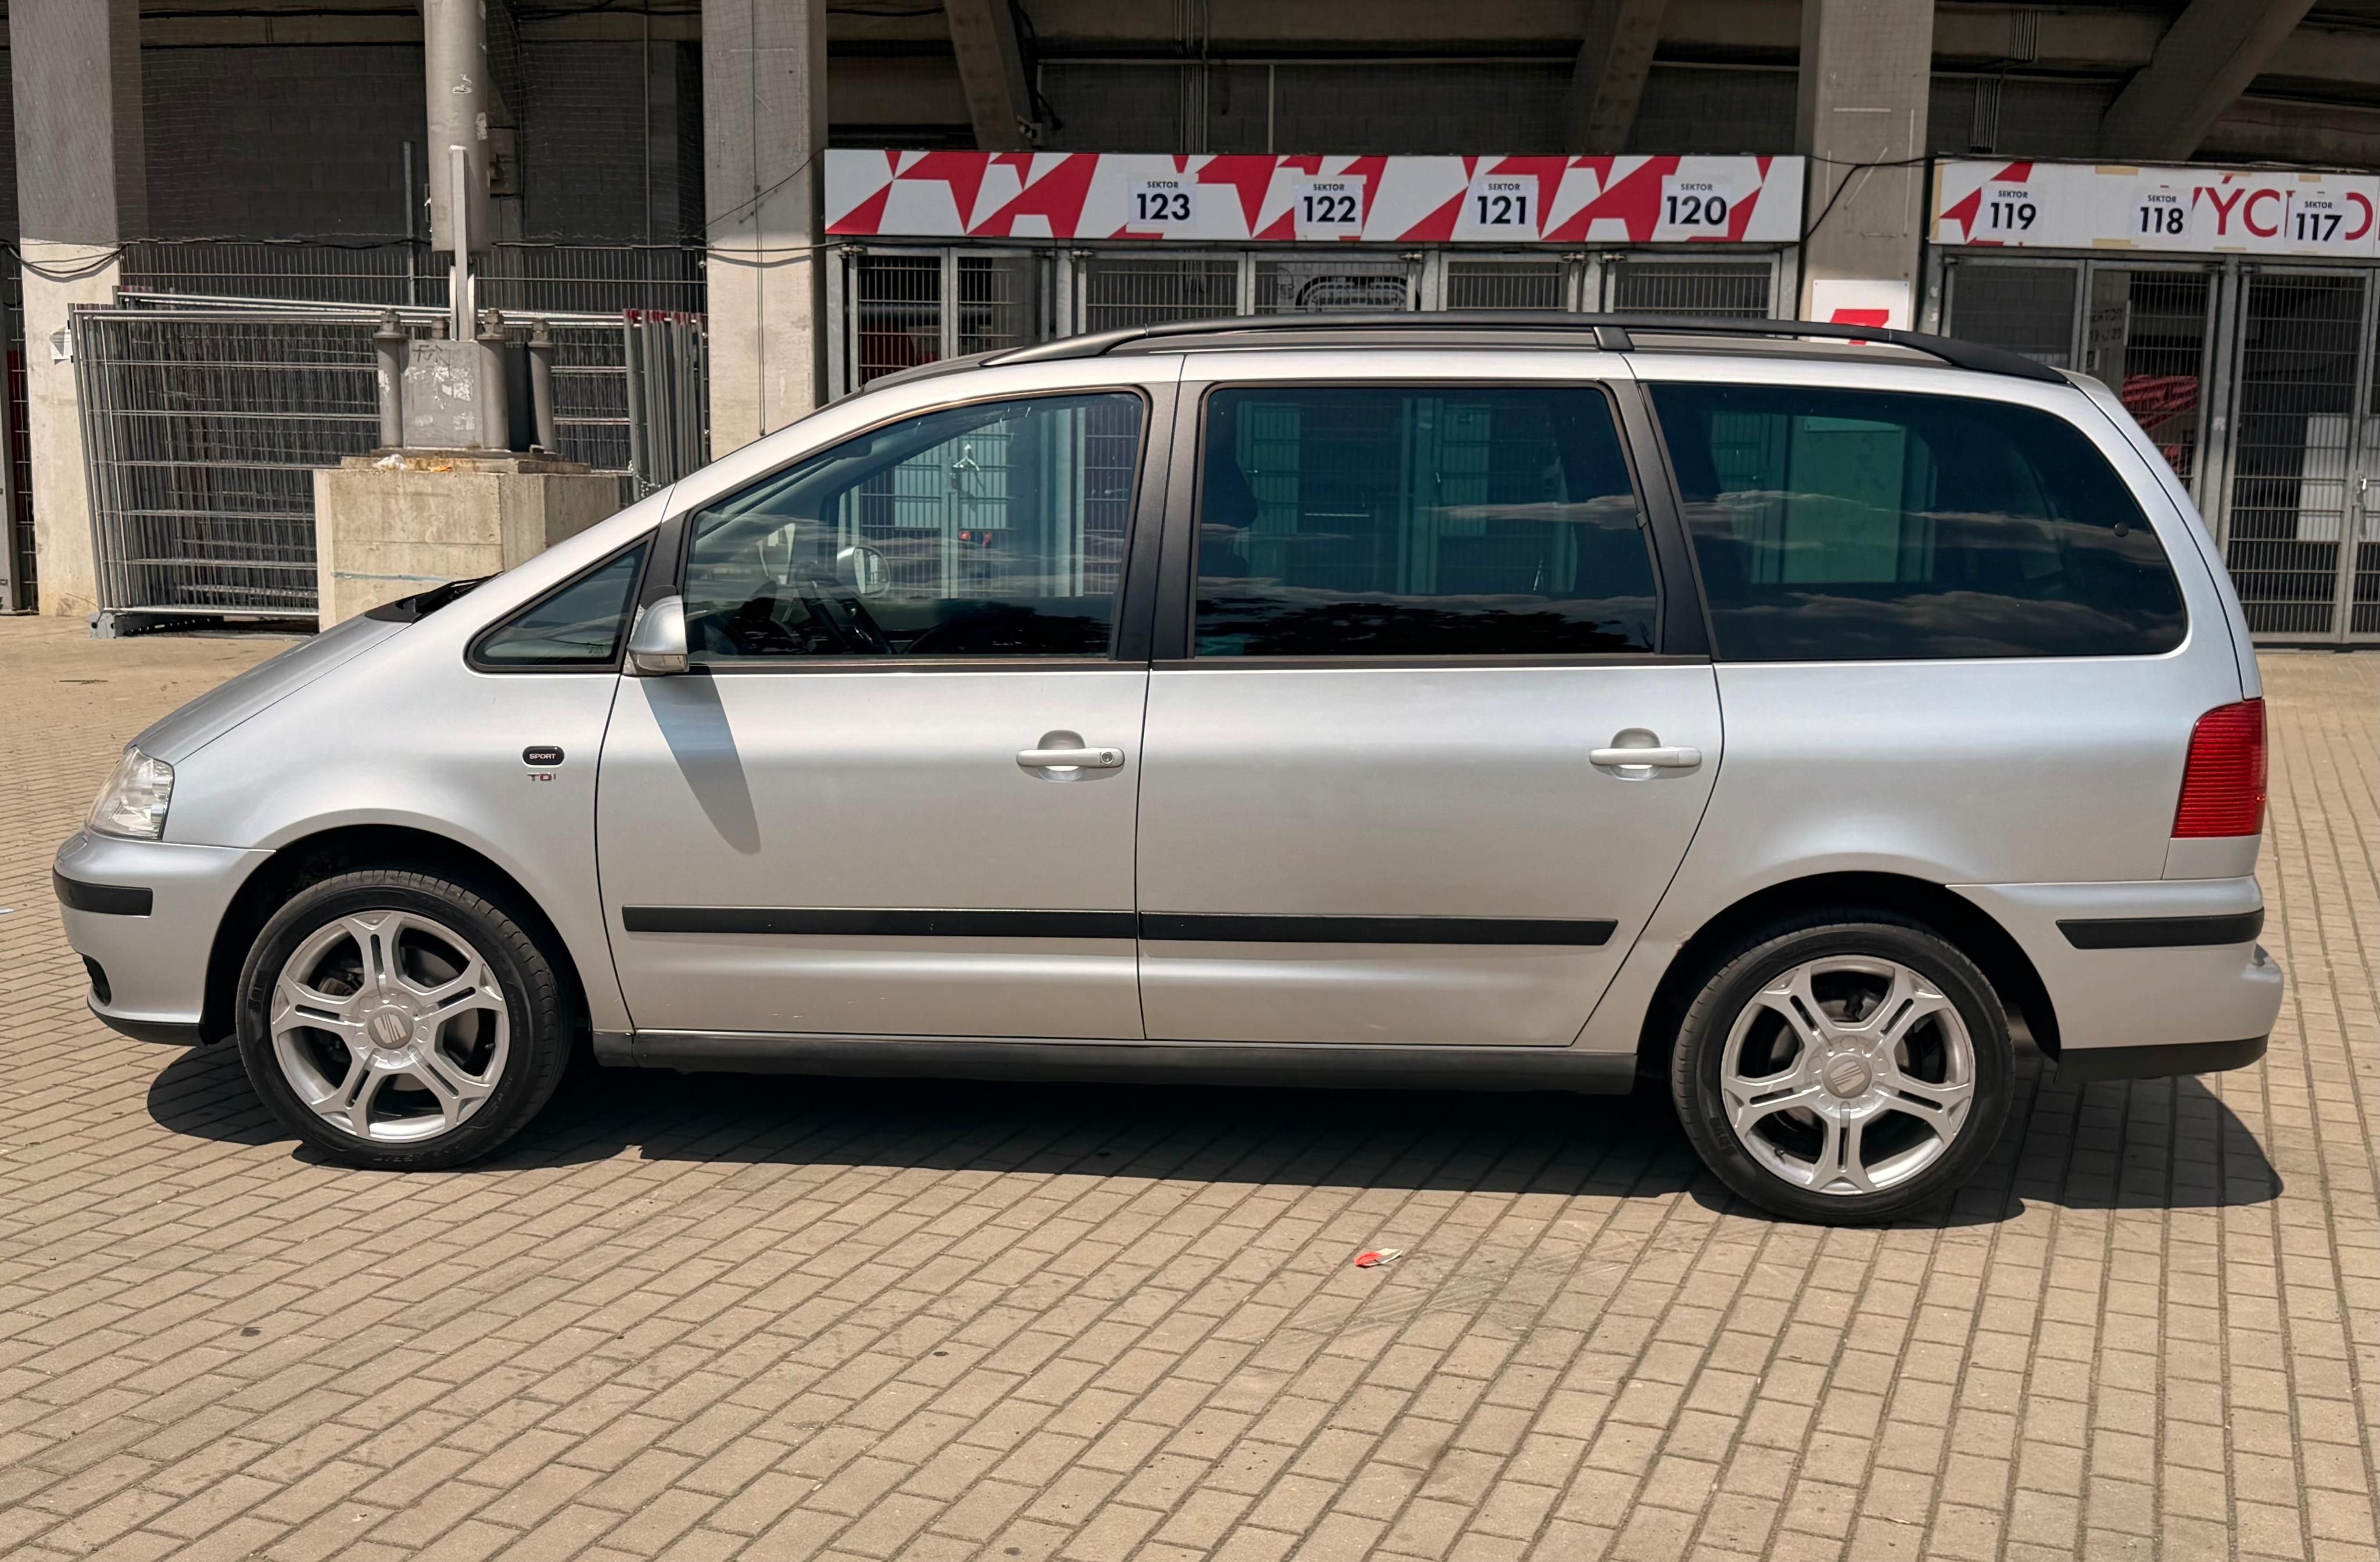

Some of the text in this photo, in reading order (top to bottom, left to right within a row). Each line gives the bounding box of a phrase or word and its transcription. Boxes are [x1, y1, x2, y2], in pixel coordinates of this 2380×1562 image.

[1137, 193, 1191, 221] 123
[1303, 195, 1356, 223] 122
[1477, 195, 1527, 225] 121
[1666, 195, 1727, 226] 120
[1990, 202, 2037, 231] 119
[2304, 201, 2333, 209] SEKTOR
[2140, 206, 2184, 235] 118
[2296, 213, 2343, 242] 117
[526, 773, 557, 782] TDI
